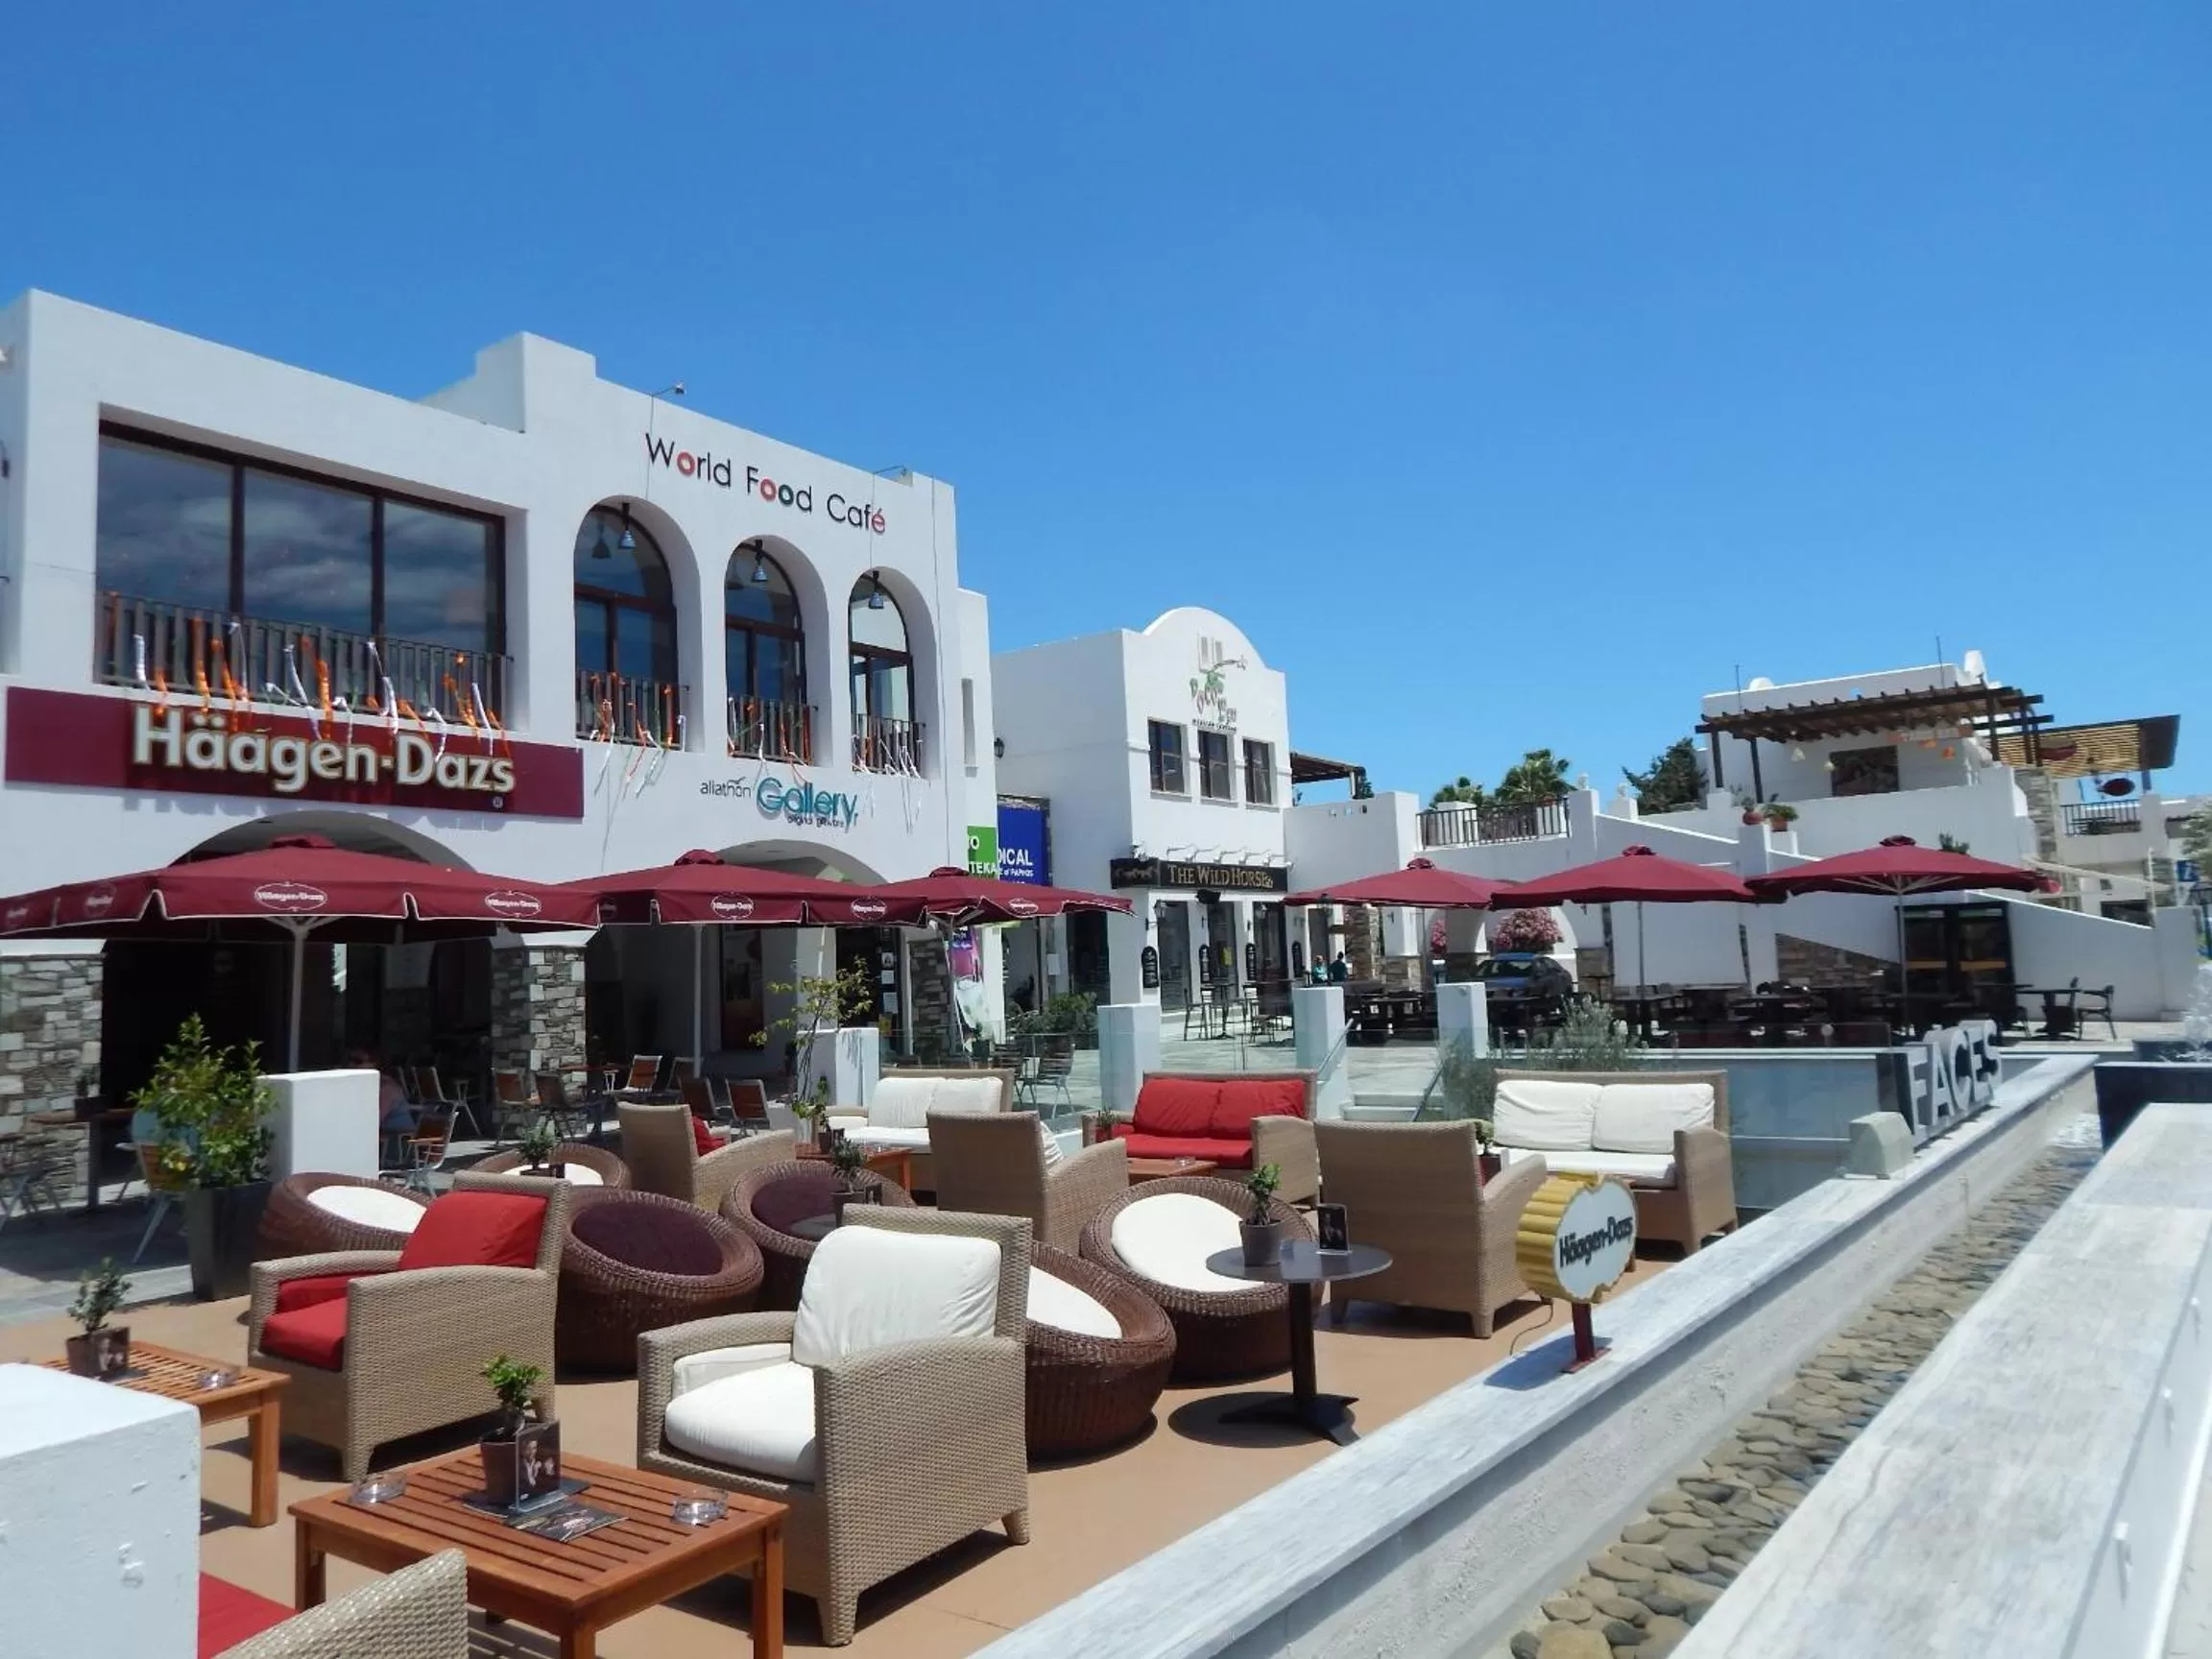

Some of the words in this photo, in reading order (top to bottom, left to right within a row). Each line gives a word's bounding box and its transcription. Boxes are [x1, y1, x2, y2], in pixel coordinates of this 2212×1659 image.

[645, 432, 731, 489] World
[746, 466, 812, 513] Food
[827, 493, 885, 534] Café
[133, 705, 517, 793] Häagen-Dazs
[757, 777, 858, 833] Gallery
[1167, 865, 1195, 884] THE
[1195, 866, 1230, 886] WILD
[1906, 1020, 2004, 1147] FACES
[1559, 1215, 1633, 1268] Häagen-Dazs
